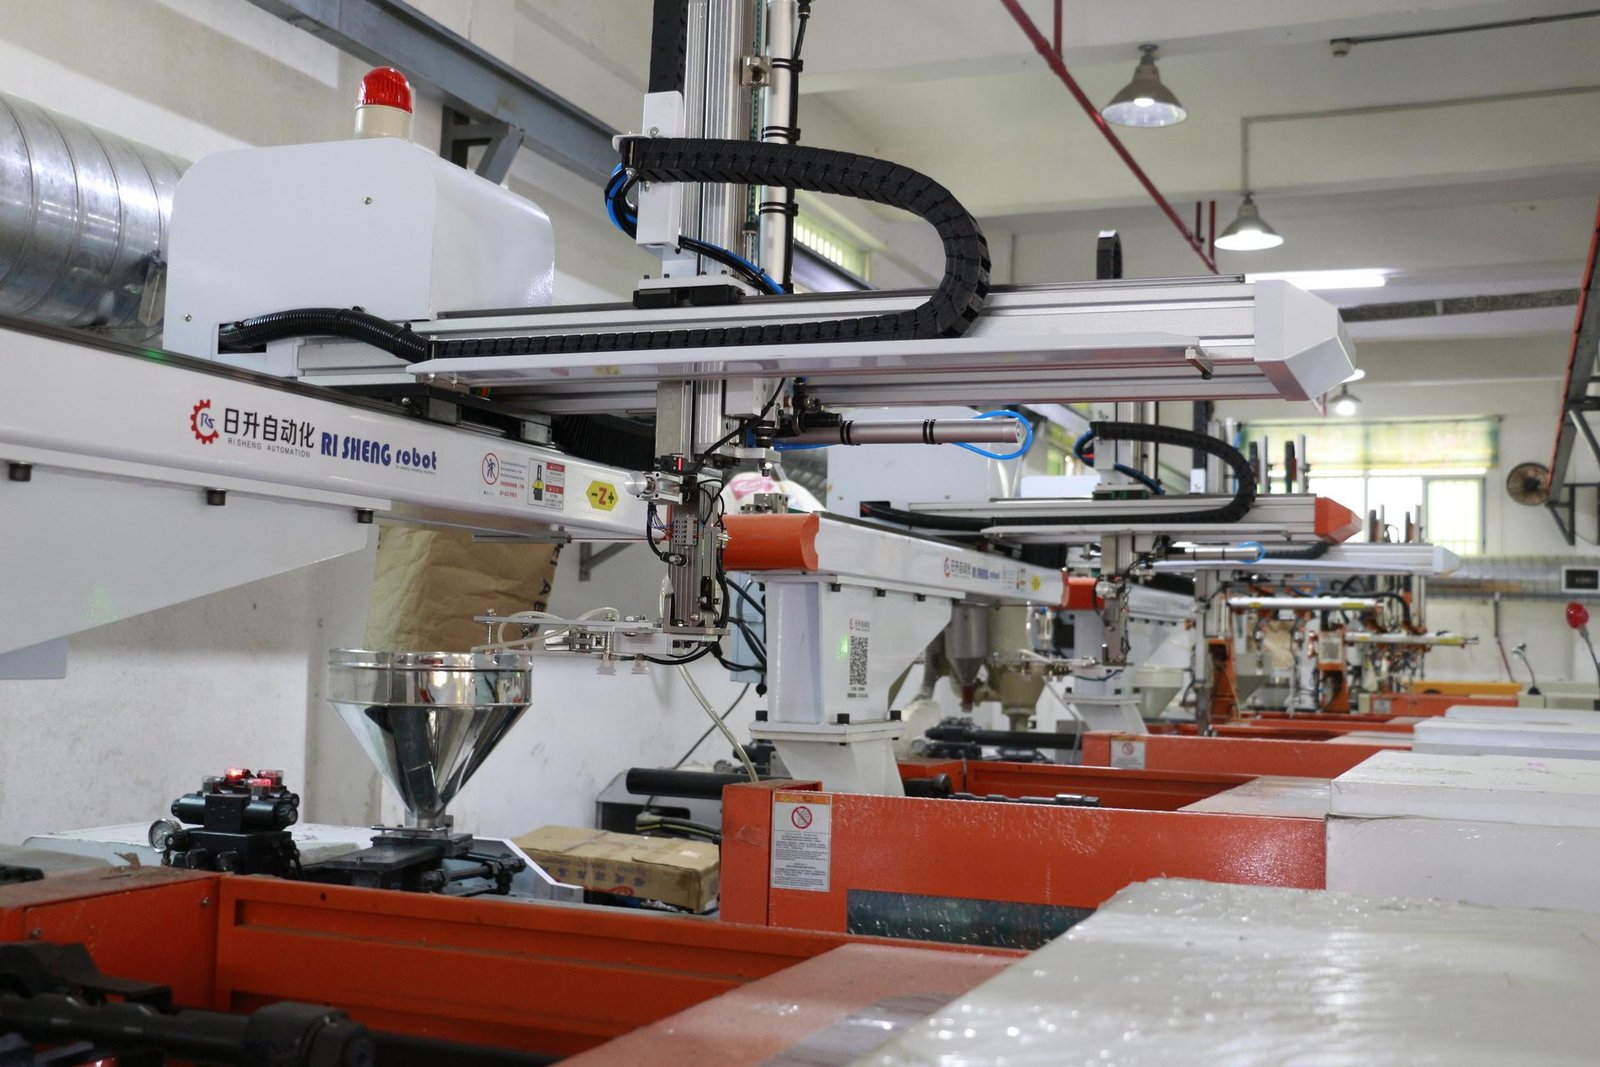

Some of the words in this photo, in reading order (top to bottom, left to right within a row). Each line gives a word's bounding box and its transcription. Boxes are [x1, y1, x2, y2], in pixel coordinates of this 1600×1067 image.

[224, 407, 316, 449] 日升自动化
[267, 444, 311, 458] AUTOMATION
[342, 436, 392, 466] SHENG
[396, 447, 437, 470] robot
